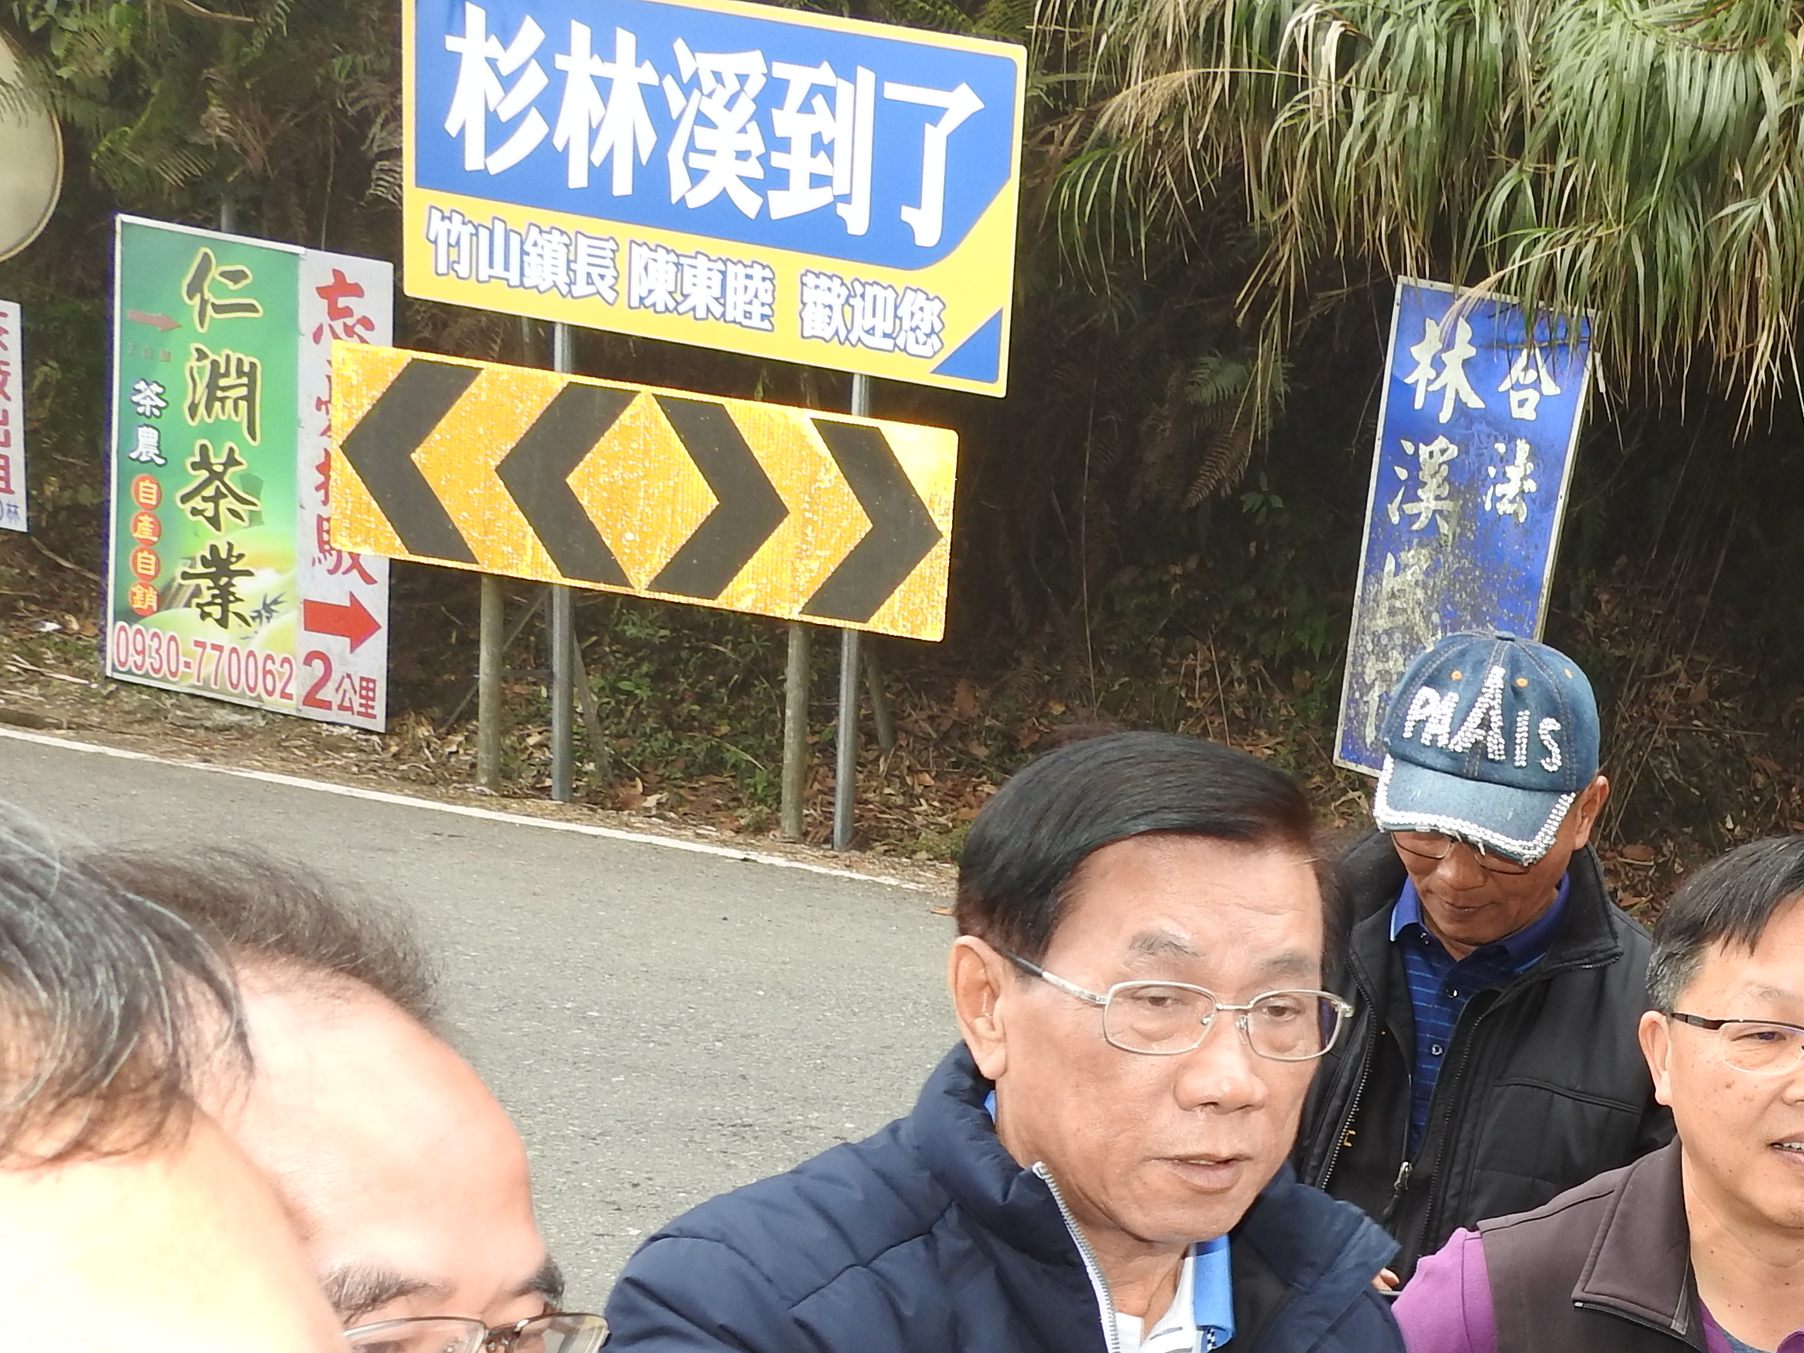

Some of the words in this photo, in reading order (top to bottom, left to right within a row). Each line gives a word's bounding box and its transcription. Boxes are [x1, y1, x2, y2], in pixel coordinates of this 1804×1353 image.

[445, 1, 985, 247] 杉林溪到了
[427, 207, 618, 304] 竹山鎮長
[629, 241, 774, 331] 陳東睦
[801, 271, 944, 357] 歡迎您
[131, 380, 167, 466] 茶農
[177, 247, 263, 630] 仁淵茶業
[115, 624, 294, 701] 0930-770062
